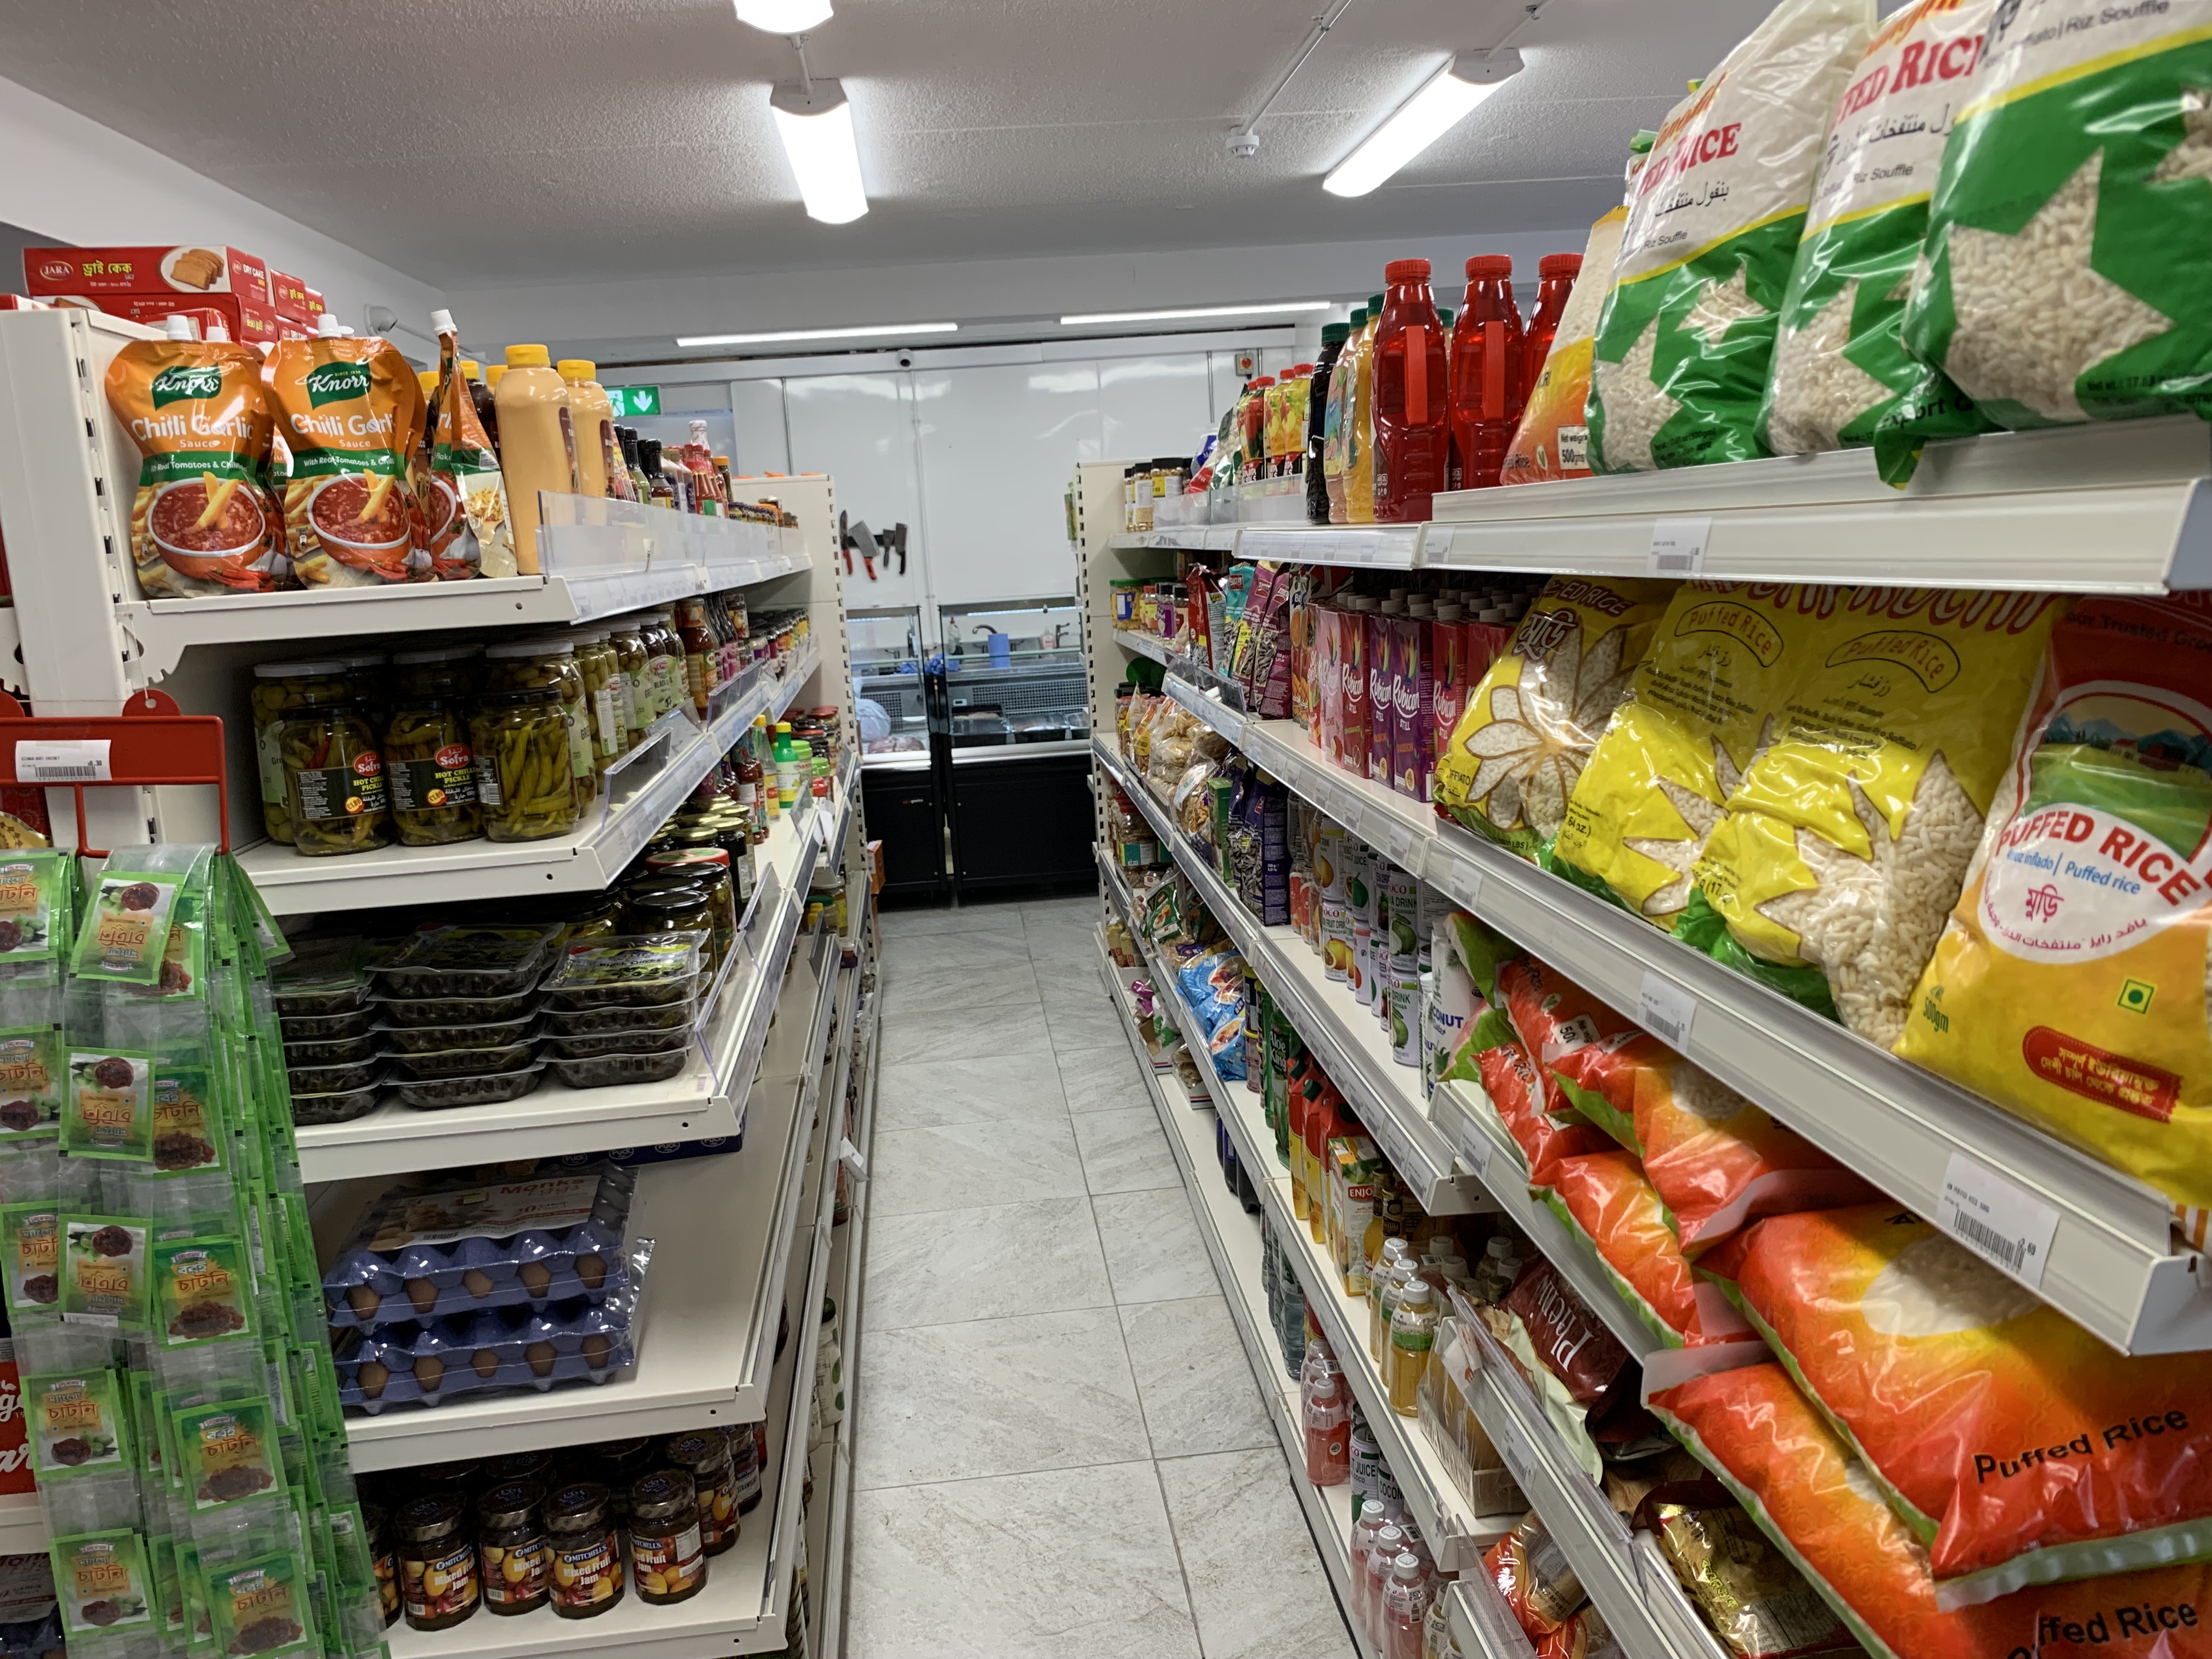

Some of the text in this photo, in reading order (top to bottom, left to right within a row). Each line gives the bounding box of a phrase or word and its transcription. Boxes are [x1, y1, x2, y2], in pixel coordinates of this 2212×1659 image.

[44, 266, 70, 275] JARA
[108, 263, 132, 274] কেক
[309, 374, 370, 393] Knorr
[132, 414, 187, 442] Chilli
[290, 413, 395, 438] Chilli Garli
[171, 461, 212, 470] Tomatoes
[304, 458, 318, 466] With
[1689, 607, 1773, 656] Puffed Rice
[1847, 636, 1946, 680] Puffed Rice
[1342, 663, 1364, 695] Rubicon
[1370, 668, 1392, 702] Rubicon
[1393, 674, 1420, 710] Rubicon
[1433, 680, 1456, 718] Rubicon
[440, 754, 469, 766] Sofra
[370, 775, 384, 784] CHILL
[435, 771, 452, 779] HOT
[444, 776, 471, 784] PICKLE
[1995, 810, 2202, 906] PUFFED RICE
[2024, 851, 2053, 871] inflado
[2064, 860, 2141, 895] Puffed rice
[2025, 883, 2064, 923] মুড়ি
[1270, 1031, 1286, 1053] Aloe
[1271, 1047, 1286, 1070] King
[500, 1178, 585, 1195] Monks
[1349, 1187, 1373, 1198] ENJO
[1973, 1408, 2190, 1485] Puffed Rice
[1356, 1462, 1376, 1477] JUICE
[514, 1556, 540, 1572] Mixed
[563, 1556, 611, 1578] Mixed Fruit
[648, 1554, 666, 1564] Fruit
[435, 1570, 462, 1586] Mixed
[453, 1576, 469, 1591] Jam
[580, 1574, 599, 1585] Jam
[2038, 1601, 2199, 1647] ffed Rice
